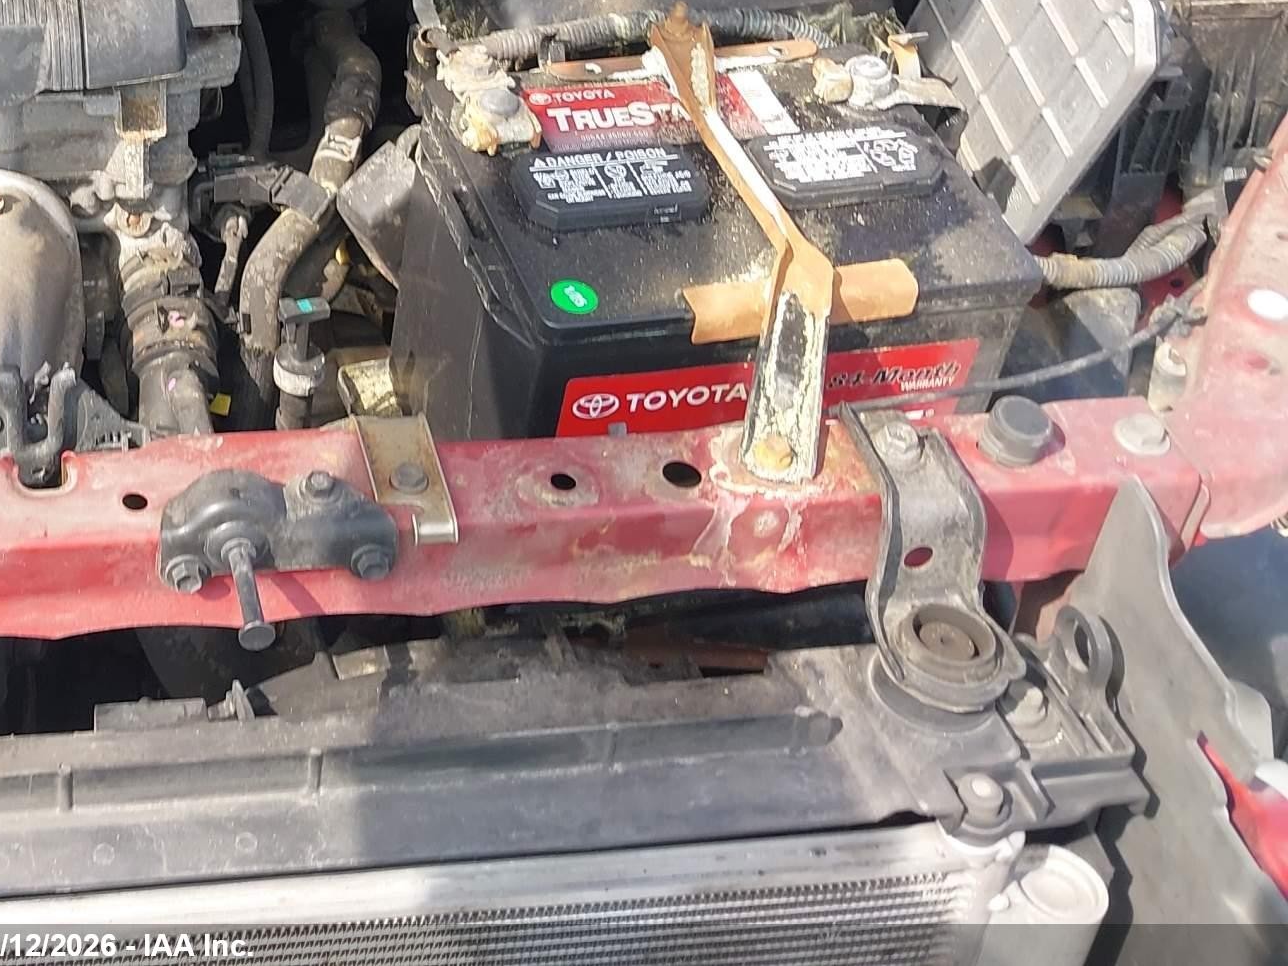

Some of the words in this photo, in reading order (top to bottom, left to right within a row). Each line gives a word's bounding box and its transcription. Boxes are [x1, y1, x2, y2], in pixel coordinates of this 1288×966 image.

[552, 89, 615, 103] TOYOTA
[546, 152, 603, 168] DANGER
[615, 147, 667, 162] POISON
[900, 376, 956, 392] WARRANTY
[626, 382, 748, 413] TOYOTA
